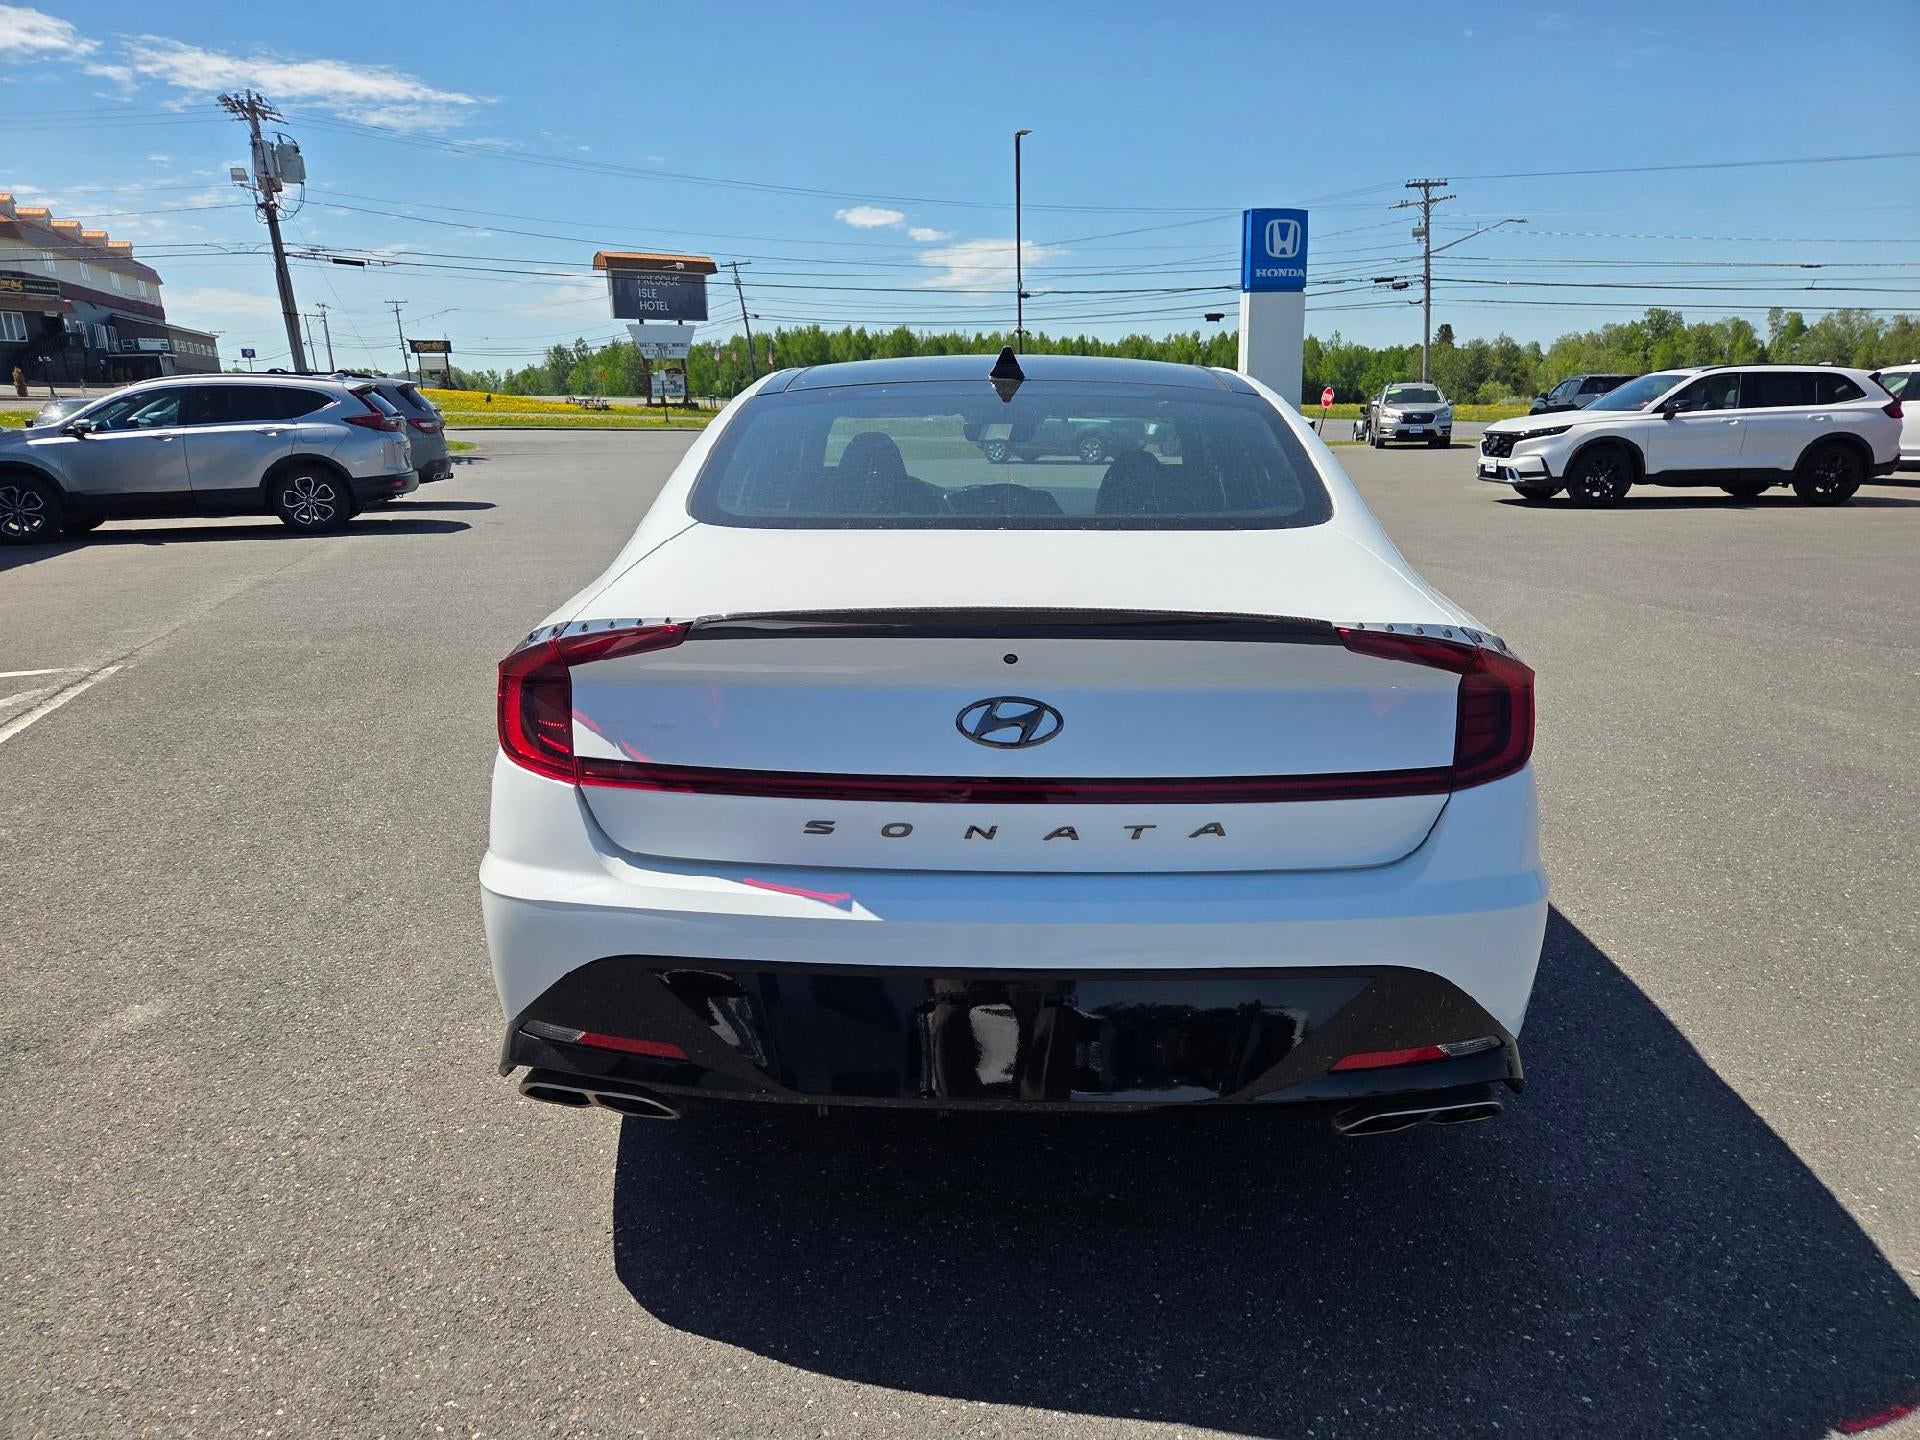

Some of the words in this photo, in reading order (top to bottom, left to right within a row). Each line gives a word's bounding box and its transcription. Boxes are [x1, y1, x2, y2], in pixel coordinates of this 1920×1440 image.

[1255, 268, 1305, 277] HONDA
[638, 288, 657, 299] ISLE
[640, 300, 670, 311] HOTEL
[802, 820, 1227, 842] SONATA
